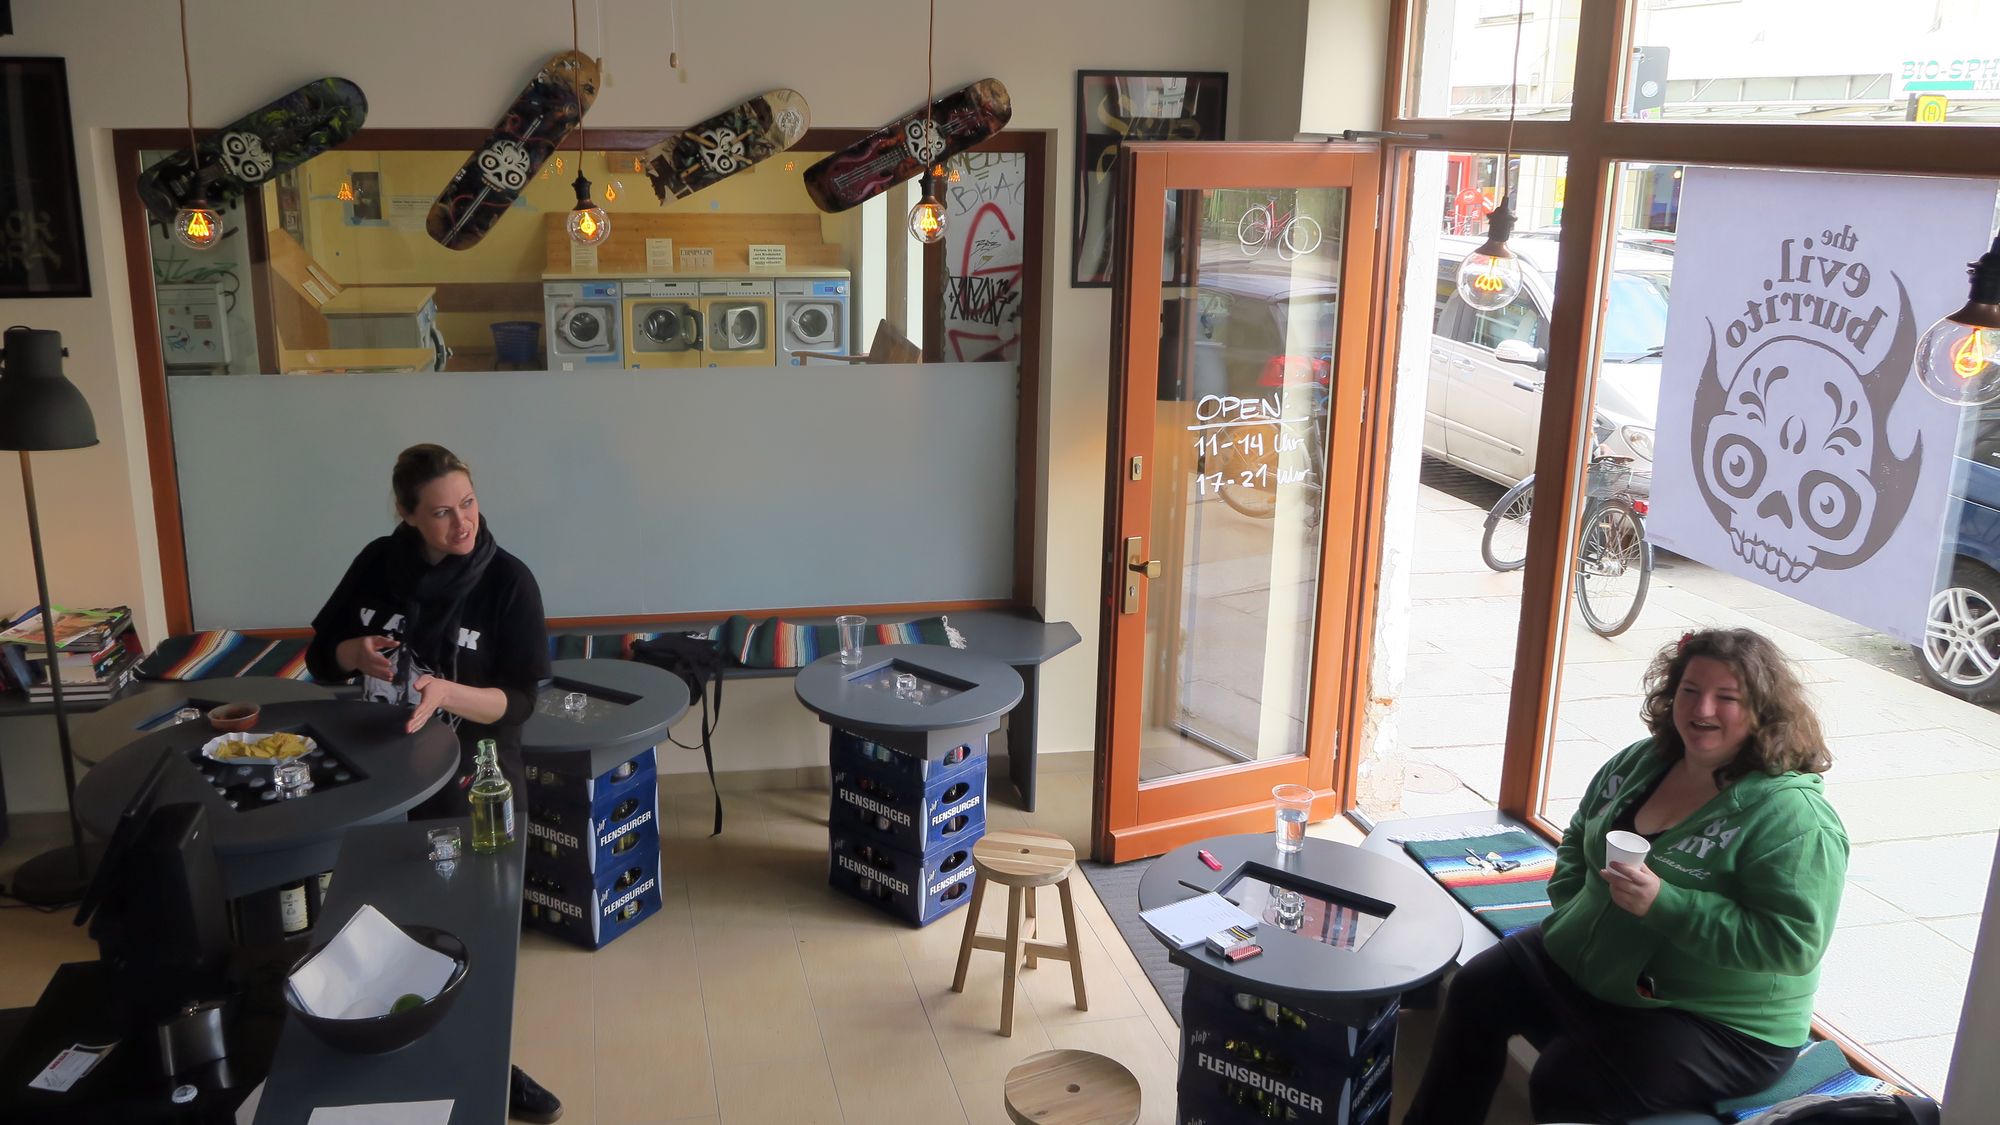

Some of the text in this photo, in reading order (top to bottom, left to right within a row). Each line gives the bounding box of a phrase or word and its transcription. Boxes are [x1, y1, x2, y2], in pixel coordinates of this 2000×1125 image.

[839, 788, 911, 827] FLENSBURGER
[932, 795, 980, 827] FLENSBURGER
[527, 822, 579, 849] SBURGER
[600, 810, 652, 847] FLENSBURGER
[838, 855, 910, 895] FLENSBURGER
[524, 888, 583, 919] NSBURGER
[603, 877, 655, 917] FLENSBURGER
[1197, 1051, 1324, 1115] FLENSBURGER
